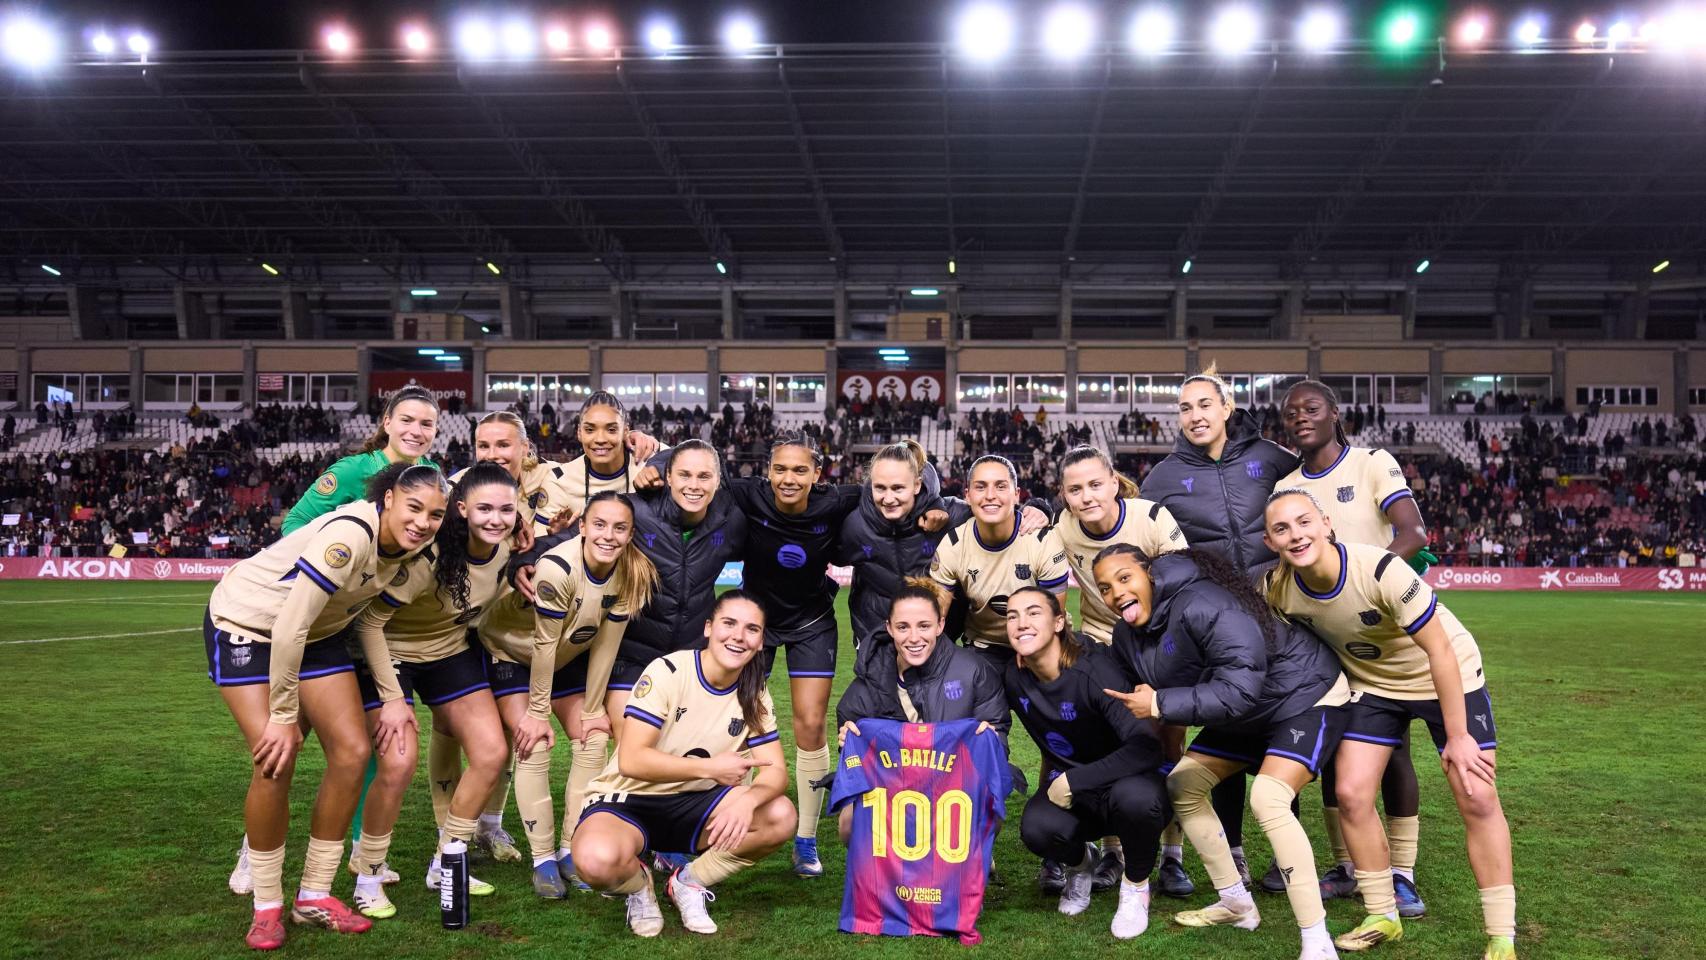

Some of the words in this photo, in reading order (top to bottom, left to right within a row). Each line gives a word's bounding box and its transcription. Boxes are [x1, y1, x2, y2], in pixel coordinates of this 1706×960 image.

[38, 560, 131, 577] AKON
[179, 563, 229, 574] Volkswa
[1565, 572, 1620, 584] CaixaBank
[1690, 572, 1706, 582] MA
[879, 751, 897, 769] O.
[900, 748, 956, 773] BATLLE
[863, 787, 973, 863] 100
[441, 868, 453, 911] PRIME
[914, 887, 942, 895] UNHCR
[914, 894, 942, 902] ACNUR
